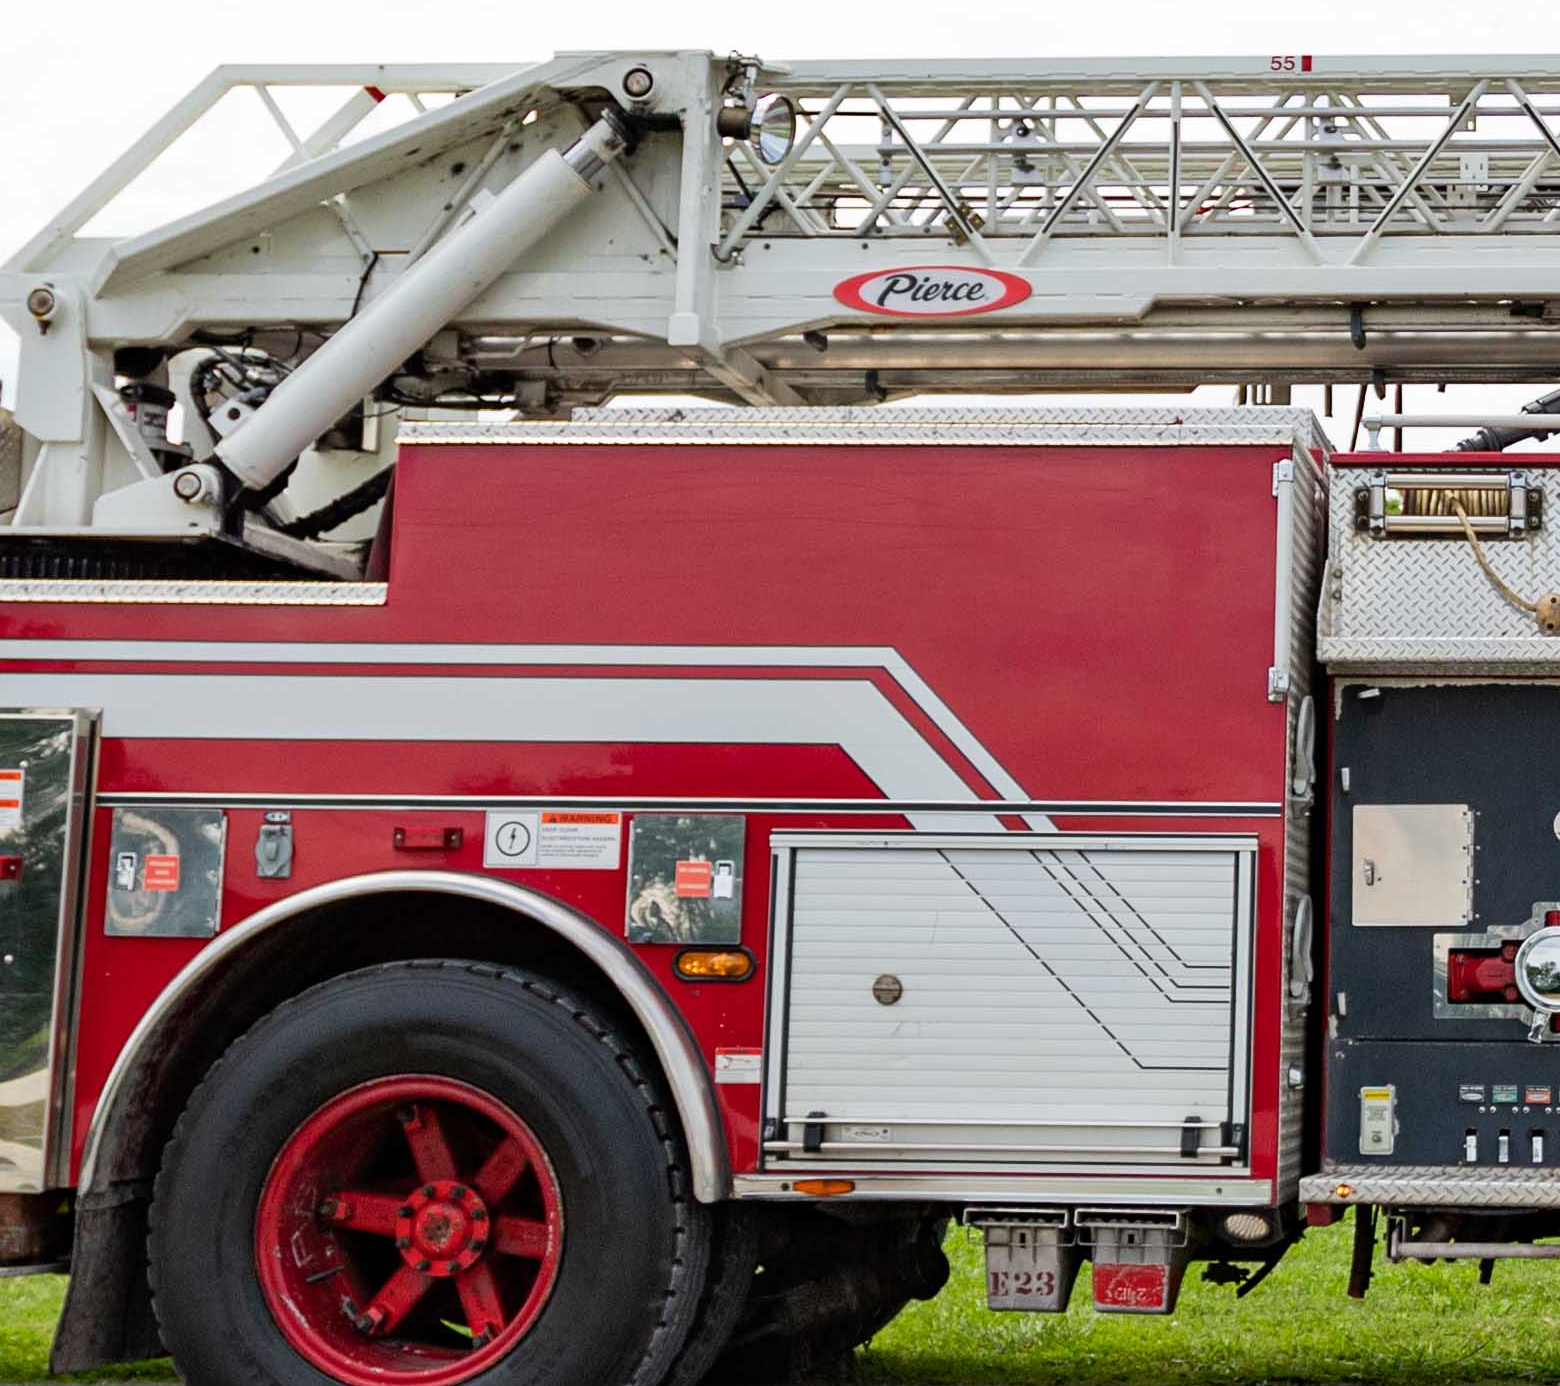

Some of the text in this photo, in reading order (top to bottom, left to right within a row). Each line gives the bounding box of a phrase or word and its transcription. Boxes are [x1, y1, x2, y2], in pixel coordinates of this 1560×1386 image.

[1271, 55, 1296, 71] 55
[876, 273, 986, 307] Pierce
[990, 1271, 1054, 1296] E23
